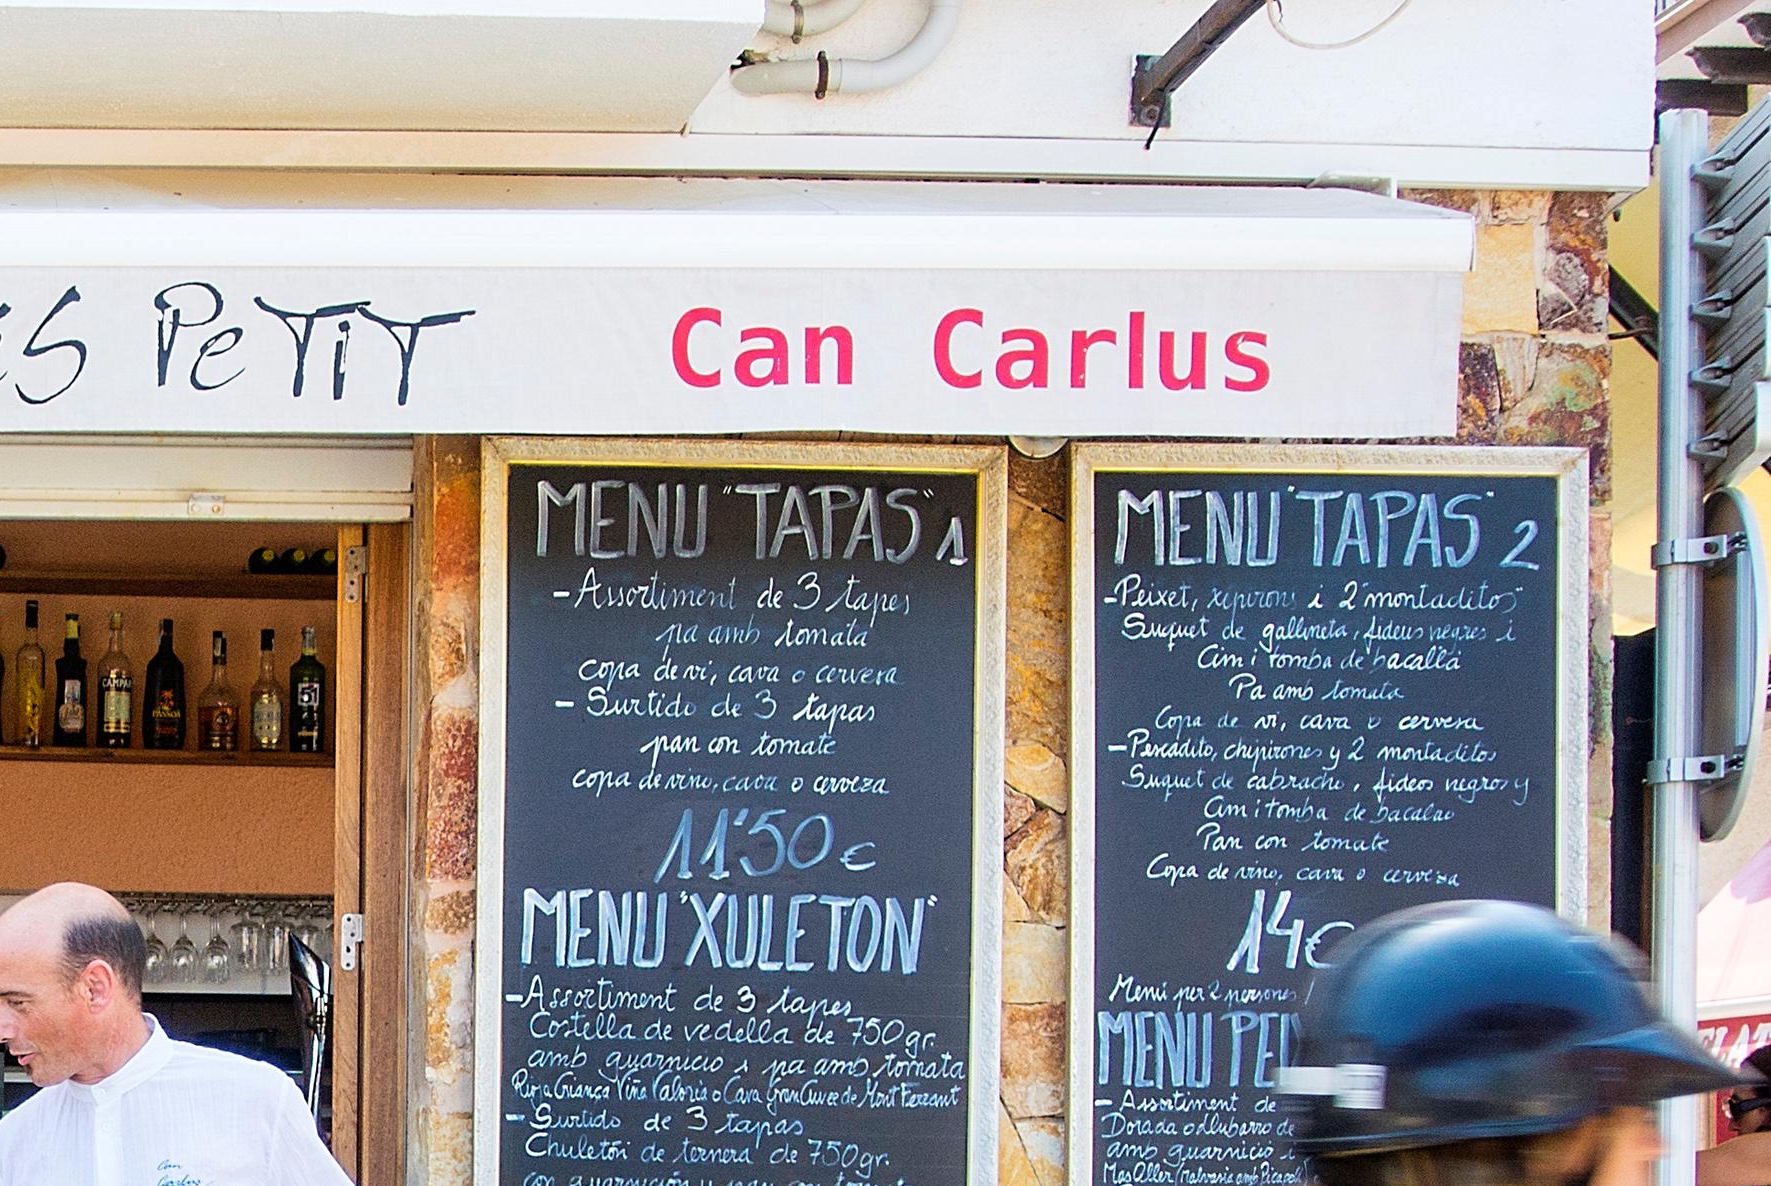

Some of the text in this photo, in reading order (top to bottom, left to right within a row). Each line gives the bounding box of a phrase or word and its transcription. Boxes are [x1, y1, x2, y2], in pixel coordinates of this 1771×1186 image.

[672, 307, 1270, 392] Can Carlus
[536, 480, 708, 559] MENU
[935, 516, 969, 566] 1
[1114, 489, 1281, 566] MENU
[1498, 519, 1539, 571] 2
[756, 580, 784, 611] de
[793, 572, 821, 612] 3
[1222, 617, 1243, 640] de
[653, 657, 780, 683] de cava
[1341, 649, 1364, 670] de
[300, 686, 318, 705] 51
[1229, 672, 1265, 700] Pa
[586, 687, 875, 733] Surtido de 3 tapas
[1217, 712, 1351, 730] de cava
[708, 731, 838, 758] con tomate
[1348, 736, 1365, 761] 2
[639, 768, 665, 790] de
[1212, 767, 1234, 789] de
[1196, 821, 1389, 852] Pan con tomate
[1208, 859, 1229, 879] de
[521, 888, 669, 969] MENU
[522, 974, 853, 1031] Assortiment de 3 tapes
[528, 1011, 835, 1046] Costella de vedella de
[528, 1046, 966, 1081] amb tomata
[1097, 1011, 1213, 1090] MENU
[1119, 1089, 1277, 1113] Assortiment de
[529, 1102, 803, 1147] Surtido de 3 tapas
[1101, 1112, 1177, 1138] Dorada
[640, 1140, 665, 1163] de
[672, 1140, 753, 1165] ternera
[769, 1141, 799, 1165] de
